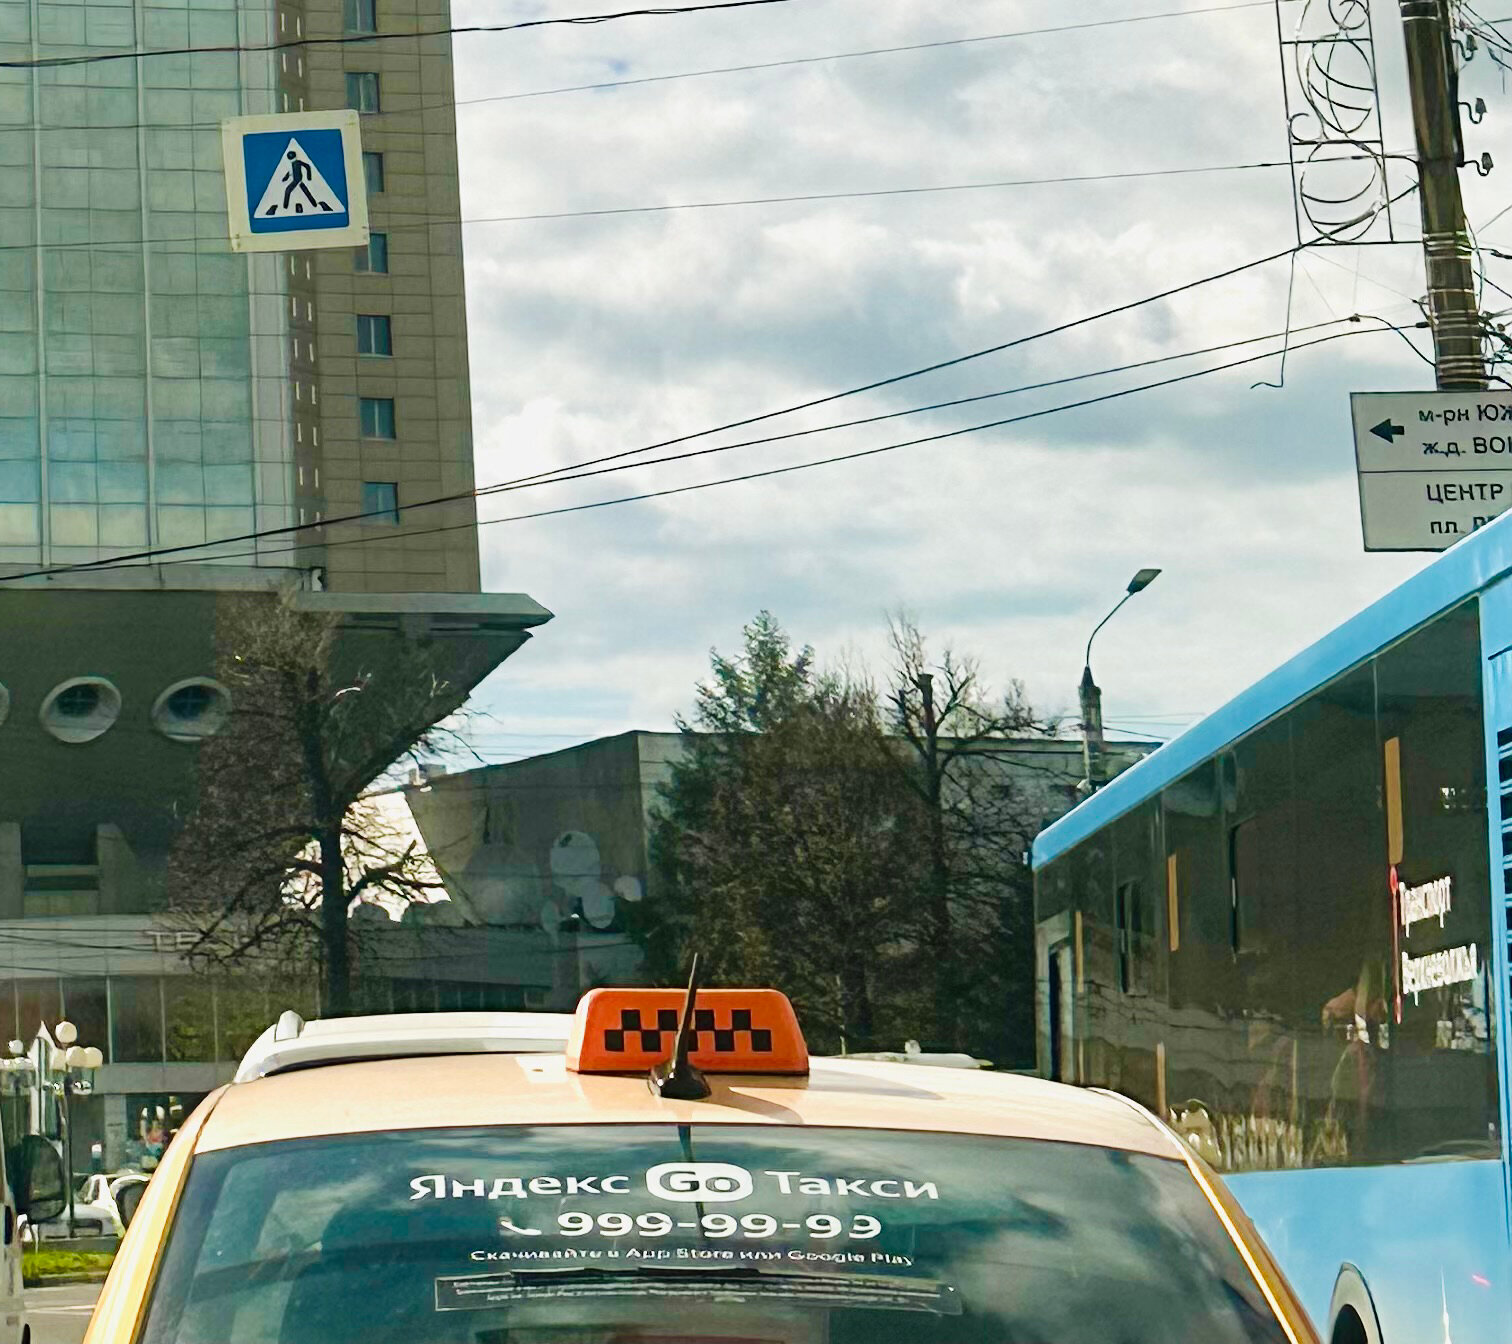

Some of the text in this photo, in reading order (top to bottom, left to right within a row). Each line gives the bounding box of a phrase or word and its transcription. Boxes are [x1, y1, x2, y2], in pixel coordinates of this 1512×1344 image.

[1418, 409, 1470, 426] м-рн
[1426, 484, 1503, 504] ЦЕНТР
[409, 1168, 939, 1200] Яндекс Go Такси
